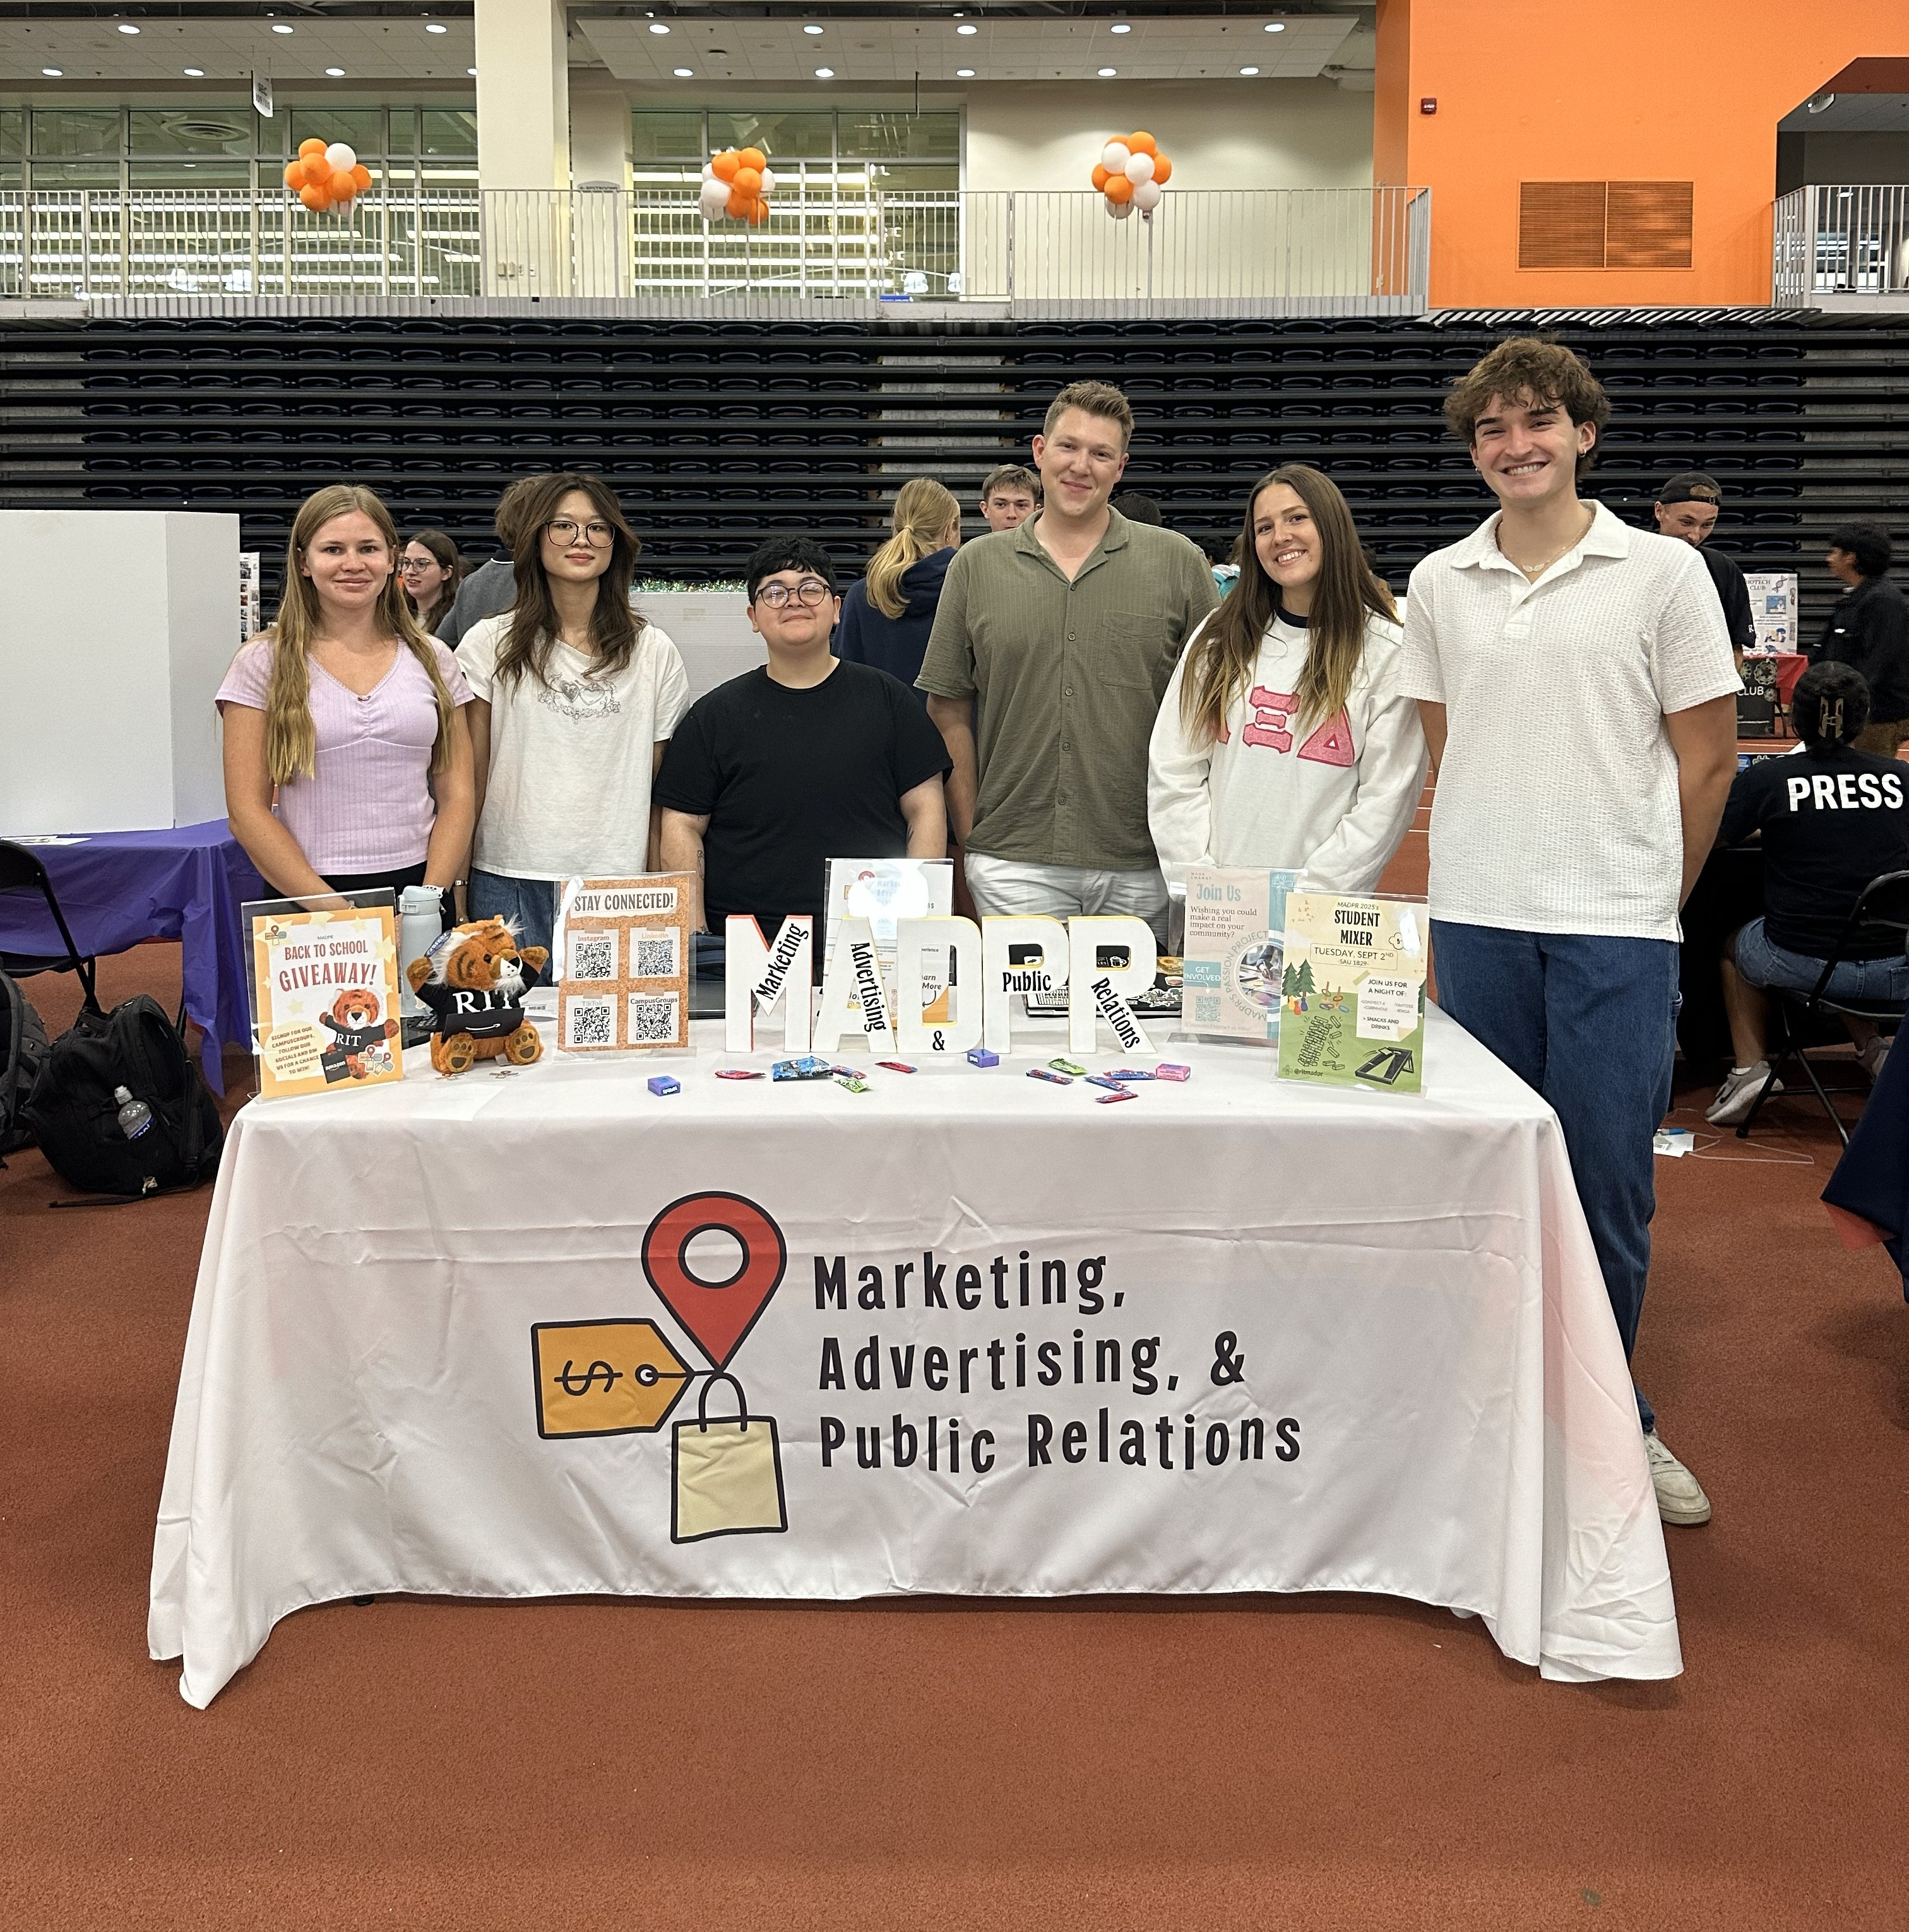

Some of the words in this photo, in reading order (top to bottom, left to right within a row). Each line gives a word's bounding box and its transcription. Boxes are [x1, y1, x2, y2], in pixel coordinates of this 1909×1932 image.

[1737, 685, 1764, 696] CLUB
[1215, 685, 1355, 767] ΞΔ
[1787, 773, 1904, 812] PRESS
[574, 895, 600, 911] STAY
[604, 892, 674, 910] CONNECTED!
[1196, 884, 1222, 901] Join
[1227, 884, 1241, 901] Us
[1190, 906, 1220, 915] Wishing
[1334, 910, 1380, 927] STUDENT
[1189, 930, 1235, 939] community?
[1231, 930, 1269, 954] PROJECT
[1340, 930, 1372, 946] MIXER
[285, 945, 311, 961] BACK
[314, 944, 326, 958] TO
[330, 940, 368, 956] SCHOOL
[1314, 947, 1355, 959] TUESDAY,
[1357, 951, 1378, 960] SEPT
[756, 923, 809, 1000] Marketing
[279, 962, 377, 992] GIVEAWAY!
[922, 982, 942, 990] More
[1002, 971, 1052, 992] Public
[1184, 973, 1221, 981] INVOLVED
[850, 942, 886, 1033] Advertising
[1091, 977, 1141, 1048] Relations
[336, 1033, 362, 1046] RIT
[932, 1030, 945, 1050] &
[813, 1250, 1126, 1315] Marketing,
[818, 1329, 1179, 1396] Advertising,
[1210, 1330, 1246, 1387] &
[820, 1413, 996, 1473] Public
[1027, 1407, 1301, 1471] Relations
